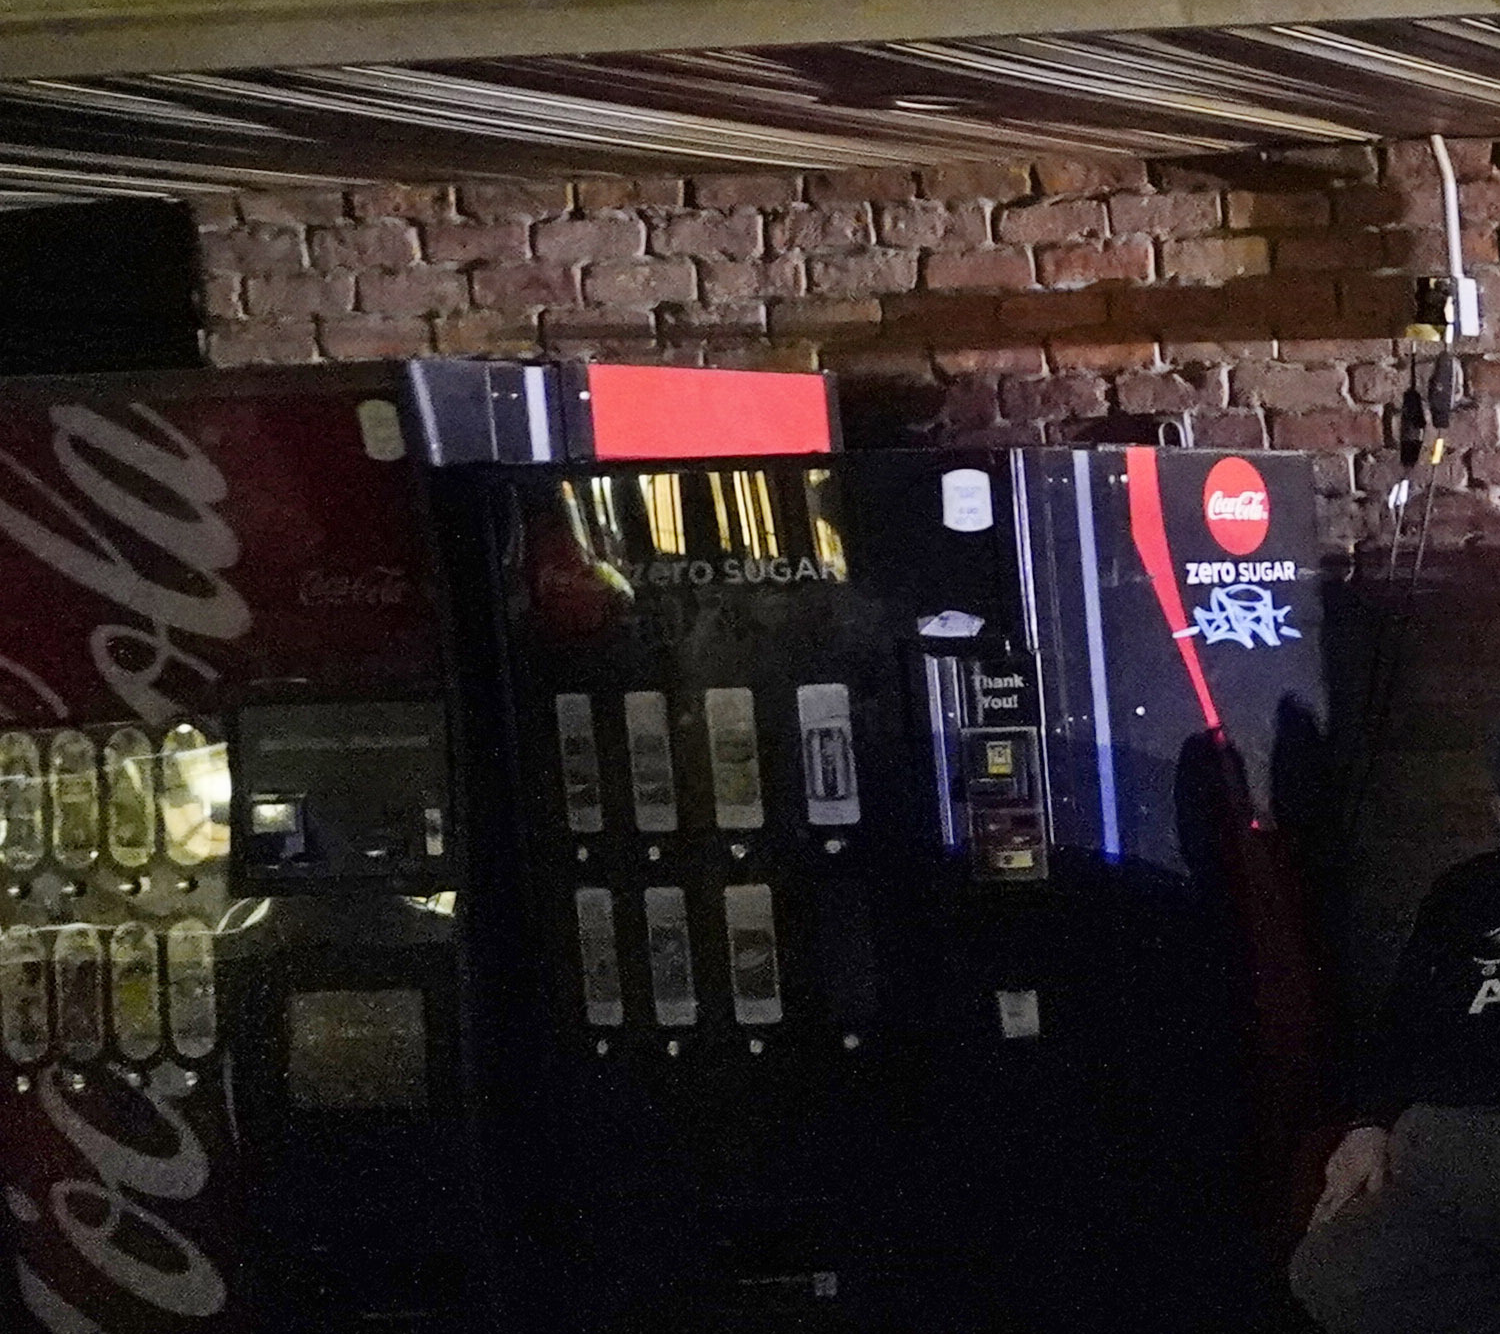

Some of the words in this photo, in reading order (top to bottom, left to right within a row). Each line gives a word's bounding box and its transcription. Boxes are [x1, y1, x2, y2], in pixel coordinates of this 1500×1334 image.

[1185, 561, 1236, 585] zero
[1238, 560, 1297, 583] SUGAR
[971, 673, 1025, 689] Thank
